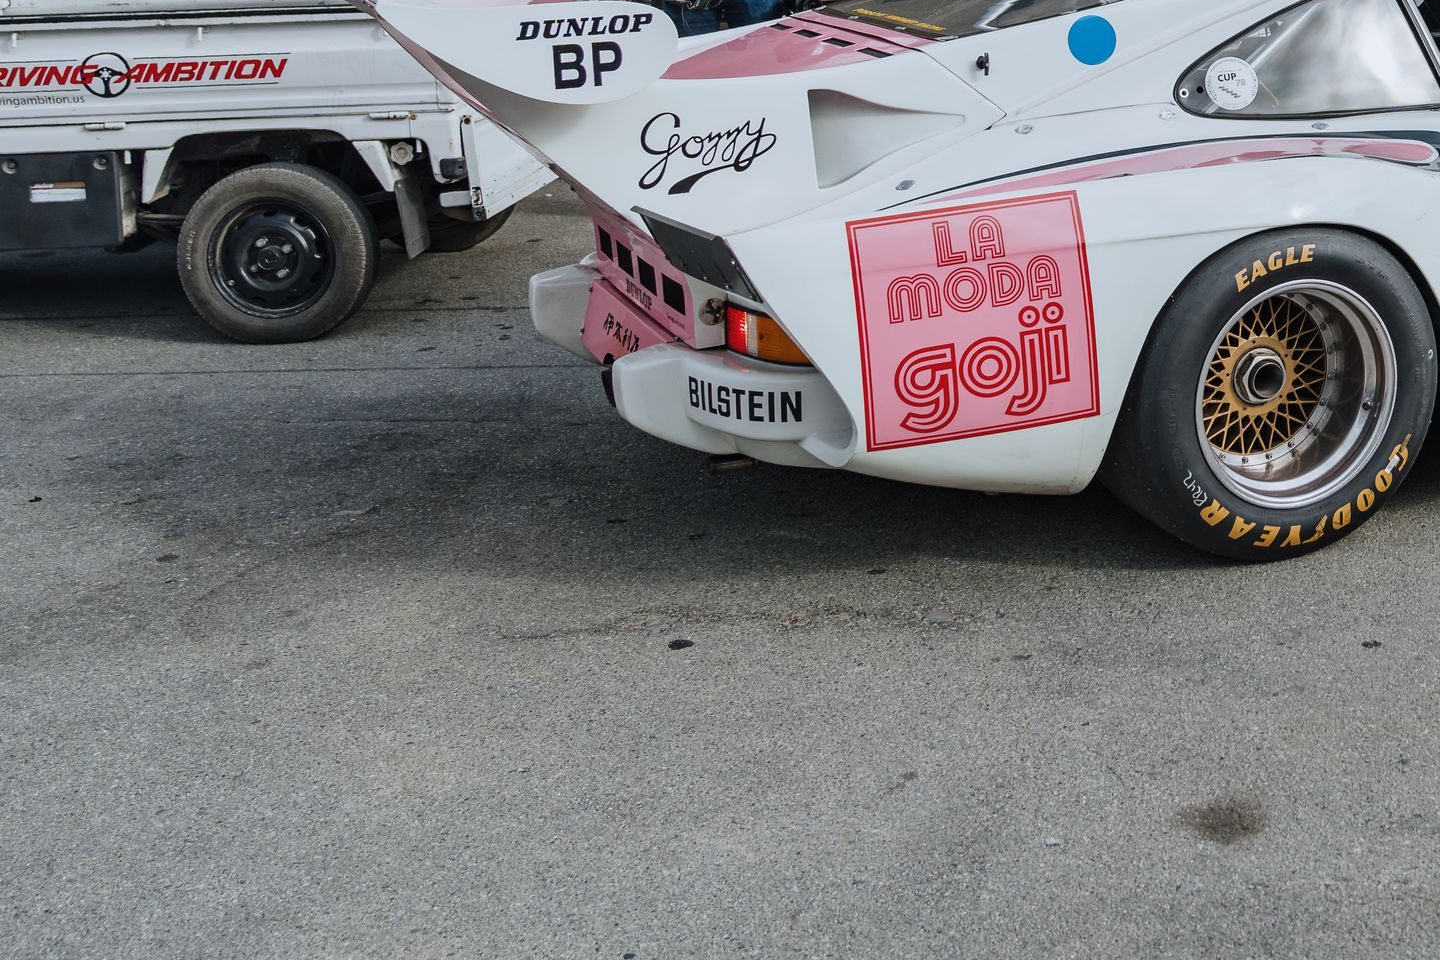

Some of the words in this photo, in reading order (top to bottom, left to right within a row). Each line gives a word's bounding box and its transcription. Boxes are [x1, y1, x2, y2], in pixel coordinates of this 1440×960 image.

[516, 13, 653, 41] DUNLOP
[113, 58, 289, 84] AMBITION
[552, 41, 623, 90] BP
[1217, 72, 1237, 82] CUP
[931, 215, 1006, 268] LA
[886, 254, 1062, 325] MODA
[1234, 243, 1316, 293] EAGLE
[625, 278, 653, 311] DUNLOP
[893, 302, 1071, 434] goji
[688, 375, 803, 423] BILSTEIN
